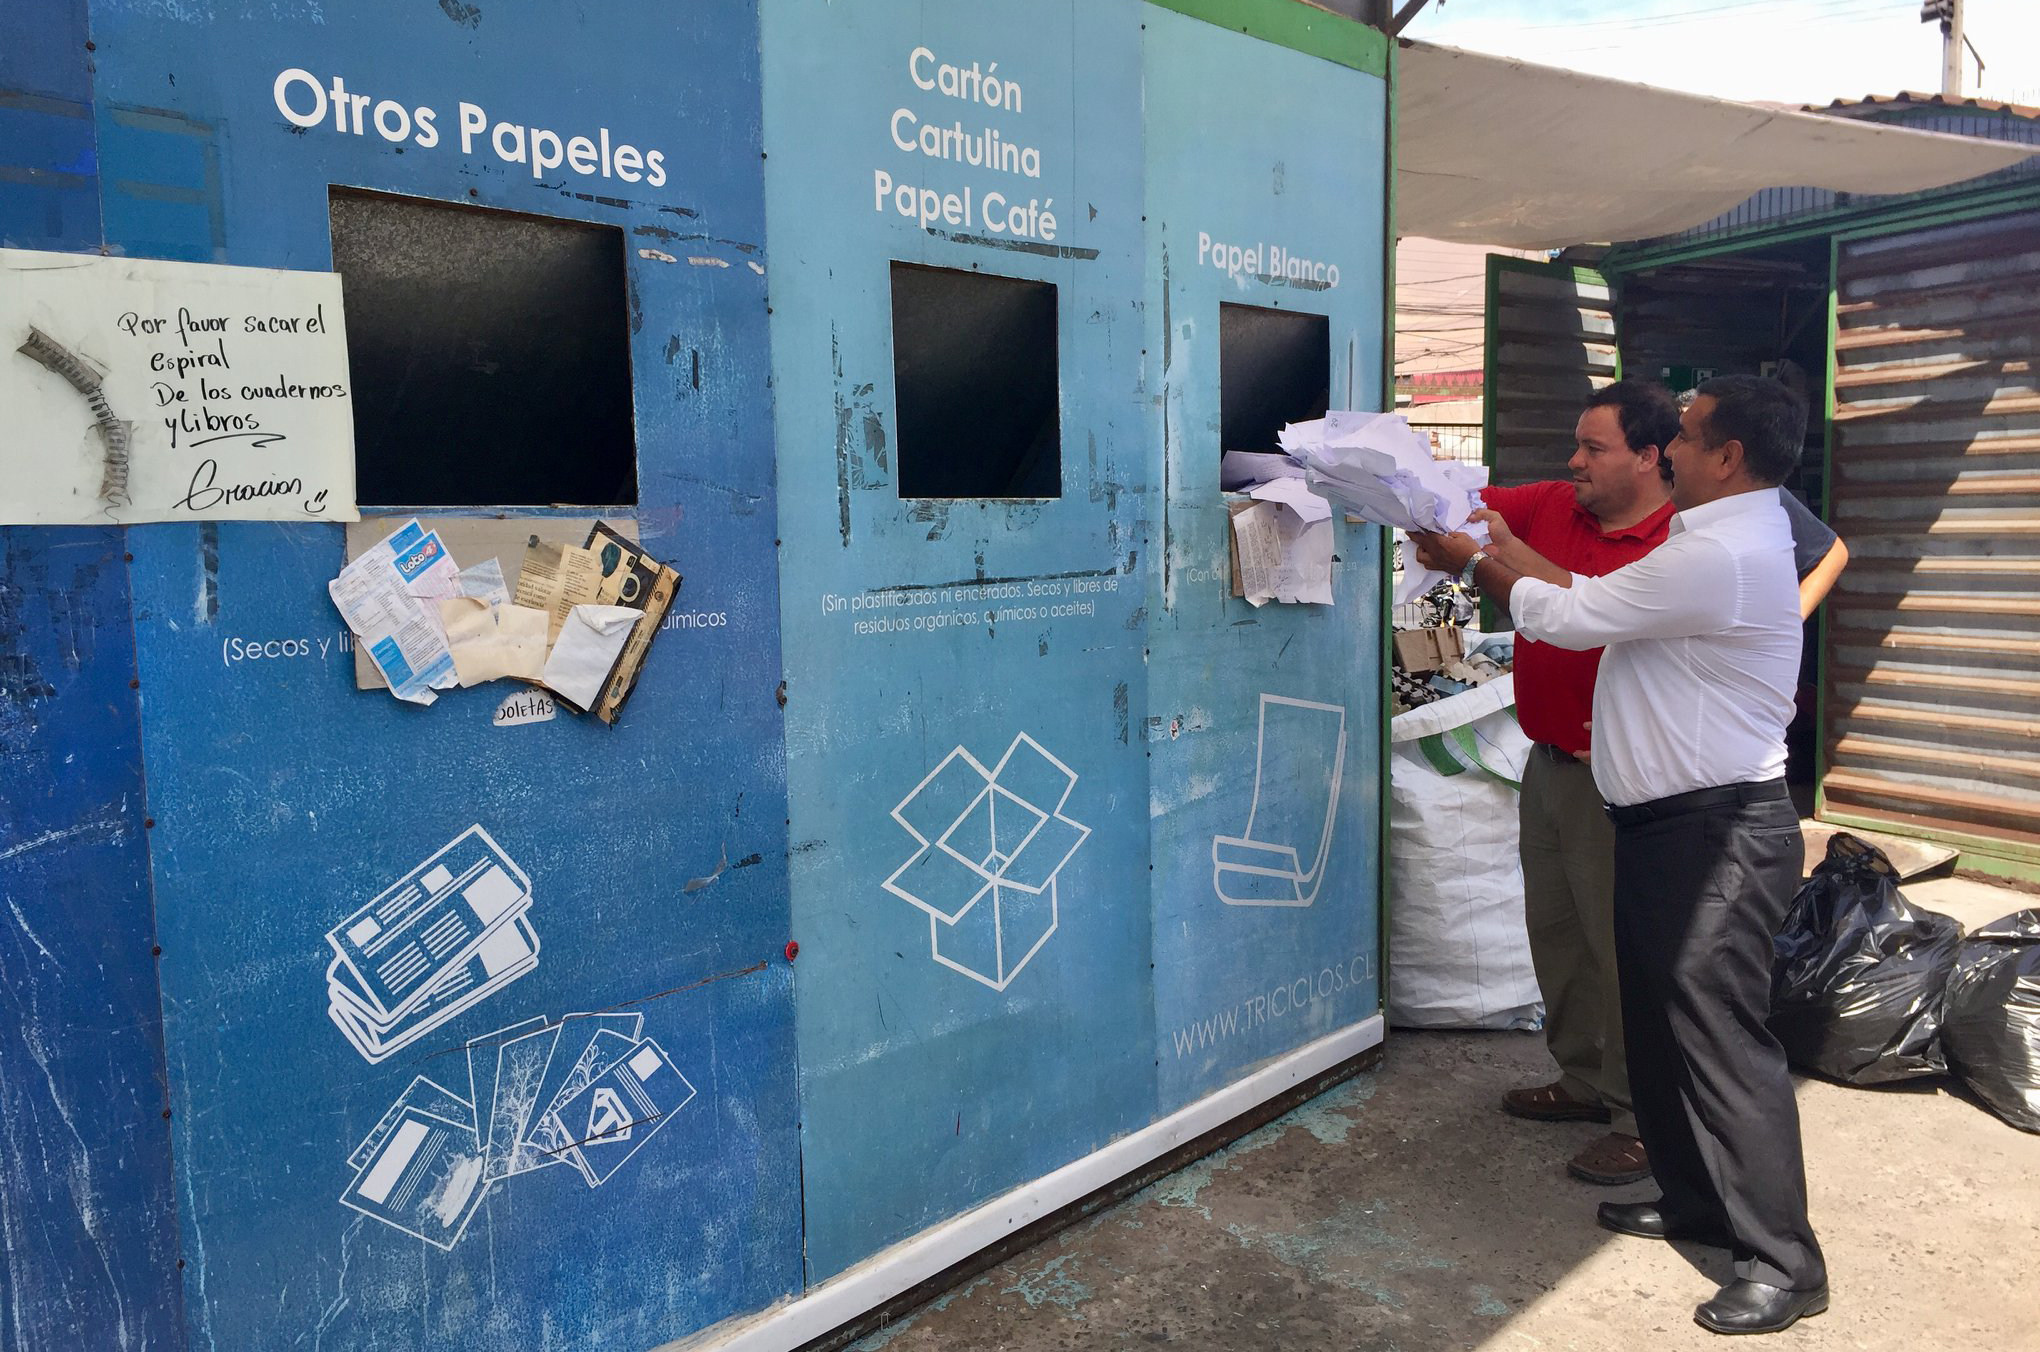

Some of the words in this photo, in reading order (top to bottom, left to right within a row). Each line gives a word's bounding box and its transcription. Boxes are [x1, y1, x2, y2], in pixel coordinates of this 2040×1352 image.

[909, 46, 1022, 113] Cartón
[273, 68, 440, 149] Otros
[459, 101, 668, 188] Papeles
[890, 108, 1041, 179] Cartulina
[874, 169, 972, 229] Papel
[982, 191, 1057, 241] Café
[1198, 231, 1263, 279] Papel
[1270, 245, 1340, 288] Blanco
[117, 311, 167, 337] Por
[175, 307, 231, 347] favor
[150, 337, 230, 379] espiral
[150, 381, 189, 407] De
[200, 378, 232, 401] los
[241, 374, 347, 400] cuadernos
[822, 593, 847, 616] (Sin
[851, 590, 937, 614] plastificados
[941, 587, 952, 603] ni
[955, 583, 1024, 601] encerados.
[1027, 580, 1061, 597] Secos
[1063, 583, 1070, 597] y
[1073, 579, 1101, 594] libres
[1103, 578, 1118, 592] de
[854, 616, 910, 635] residuos
[913, 610, 980, 632] orgánicos,
[983, 605, 1037, 626] químicos
[1039, 606, 1047, 619] o
[1050, 599, 1095, 618] aceites)
[223, 637, 310, 668] (Secos
[317, 637, 331, 660] y
[1173, 952, 1374, 1060] WWW.TRICICLOS.CL
